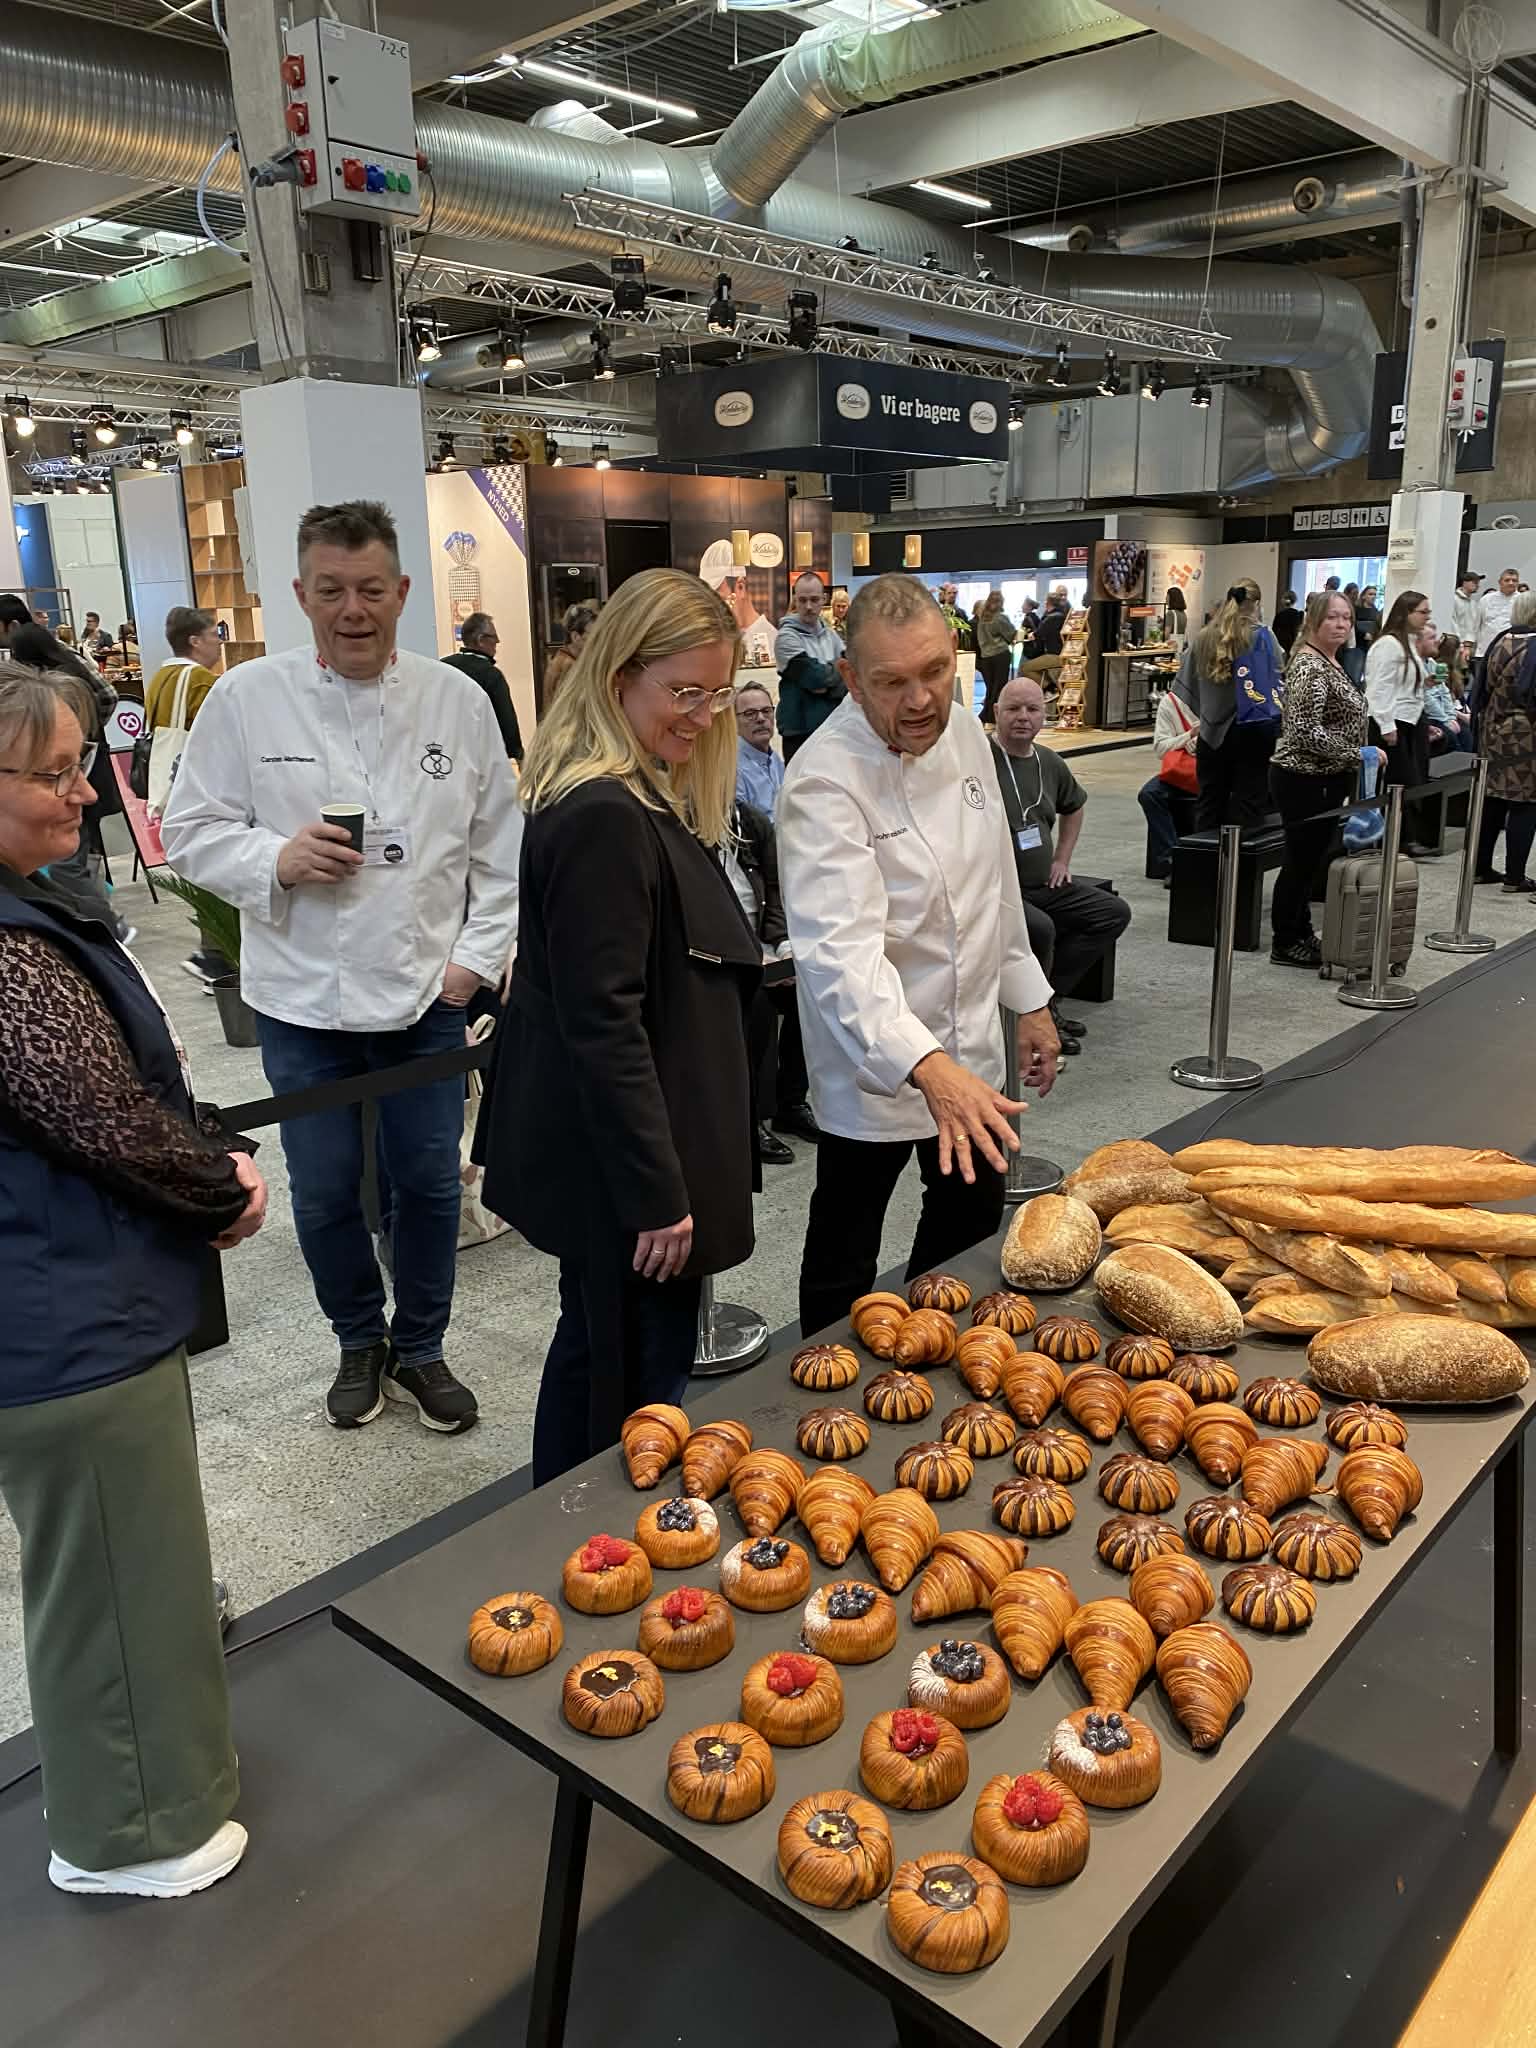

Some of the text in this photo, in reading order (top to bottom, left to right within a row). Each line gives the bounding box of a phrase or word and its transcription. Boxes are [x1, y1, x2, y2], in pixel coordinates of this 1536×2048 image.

[380, 40, 407, 59] 7-2-C
[880, 394, 896, 415] Vi
[898, 400, 913, 417] er
[915, 398, 960, 425] bagere
[487, 488, 509, 522] NYHED
[1313, 513, 1329, 526] J2
